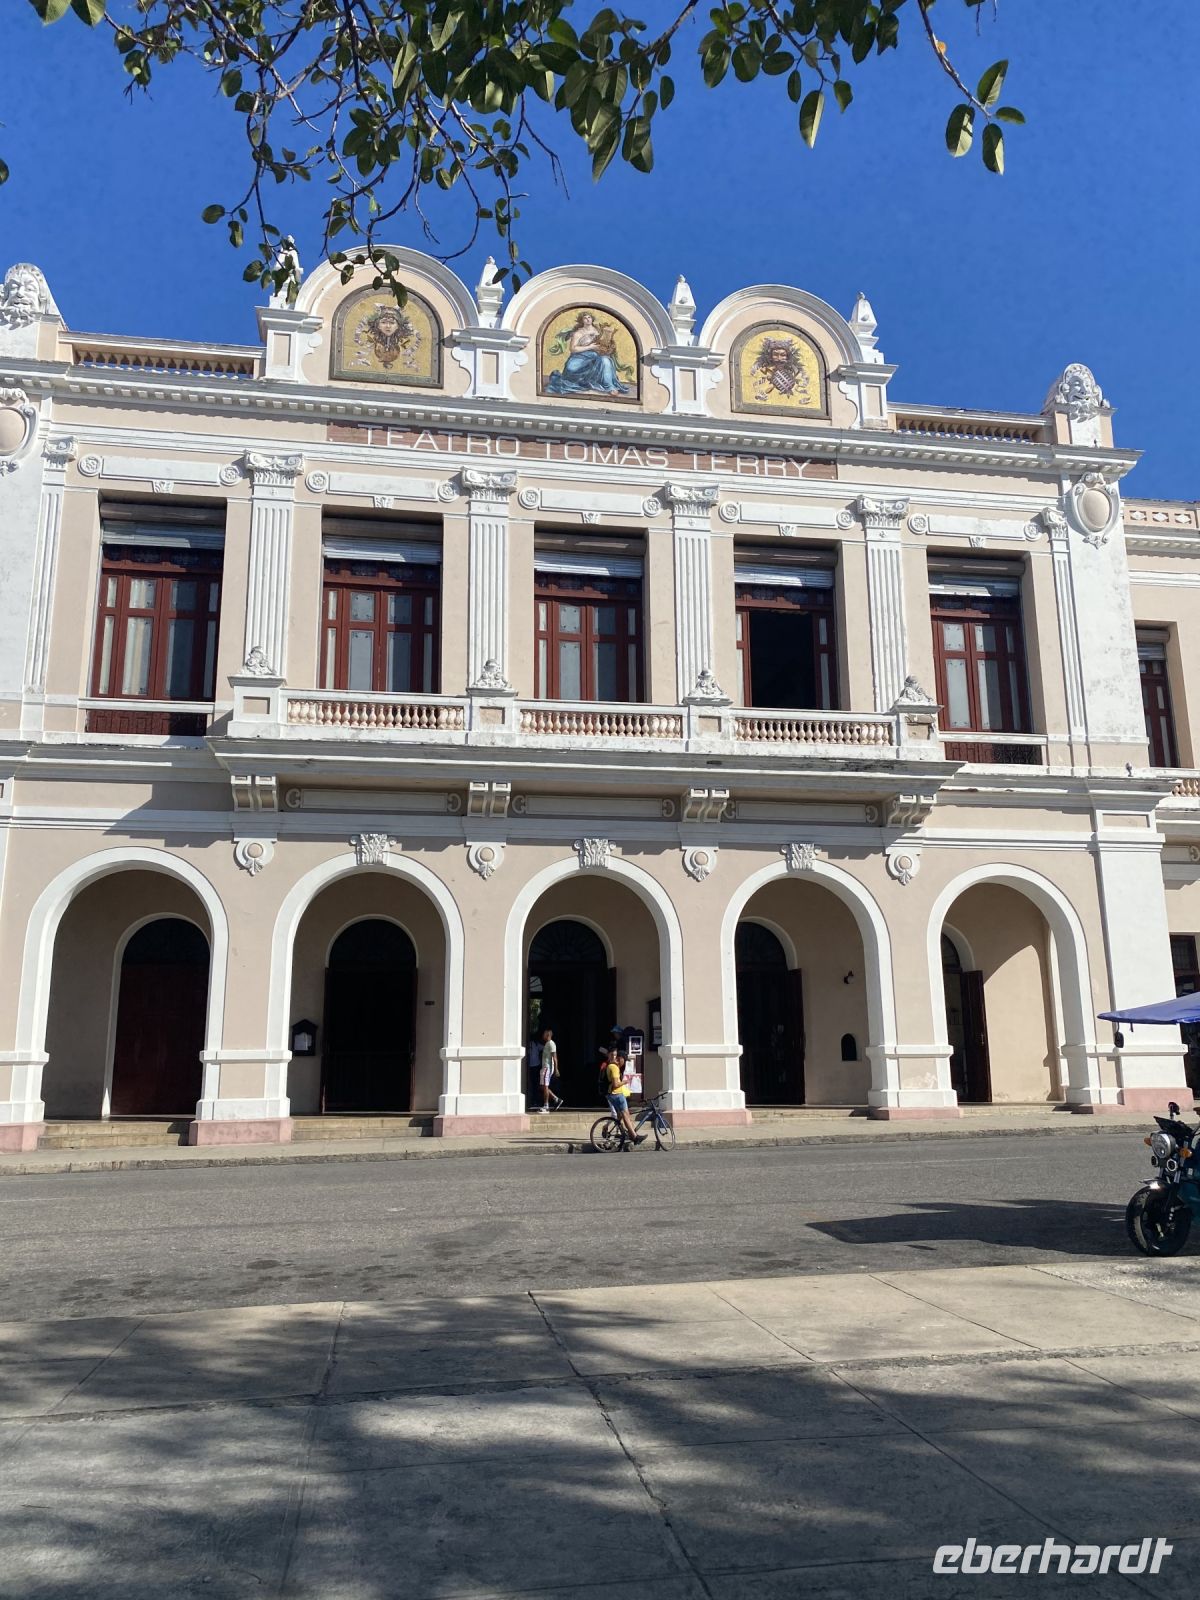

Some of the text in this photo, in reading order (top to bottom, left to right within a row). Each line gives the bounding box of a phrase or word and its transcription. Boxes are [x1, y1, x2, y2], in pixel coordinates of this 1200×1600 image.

[357, 423, 811, 477] TEATRO TOMAS TERRY
